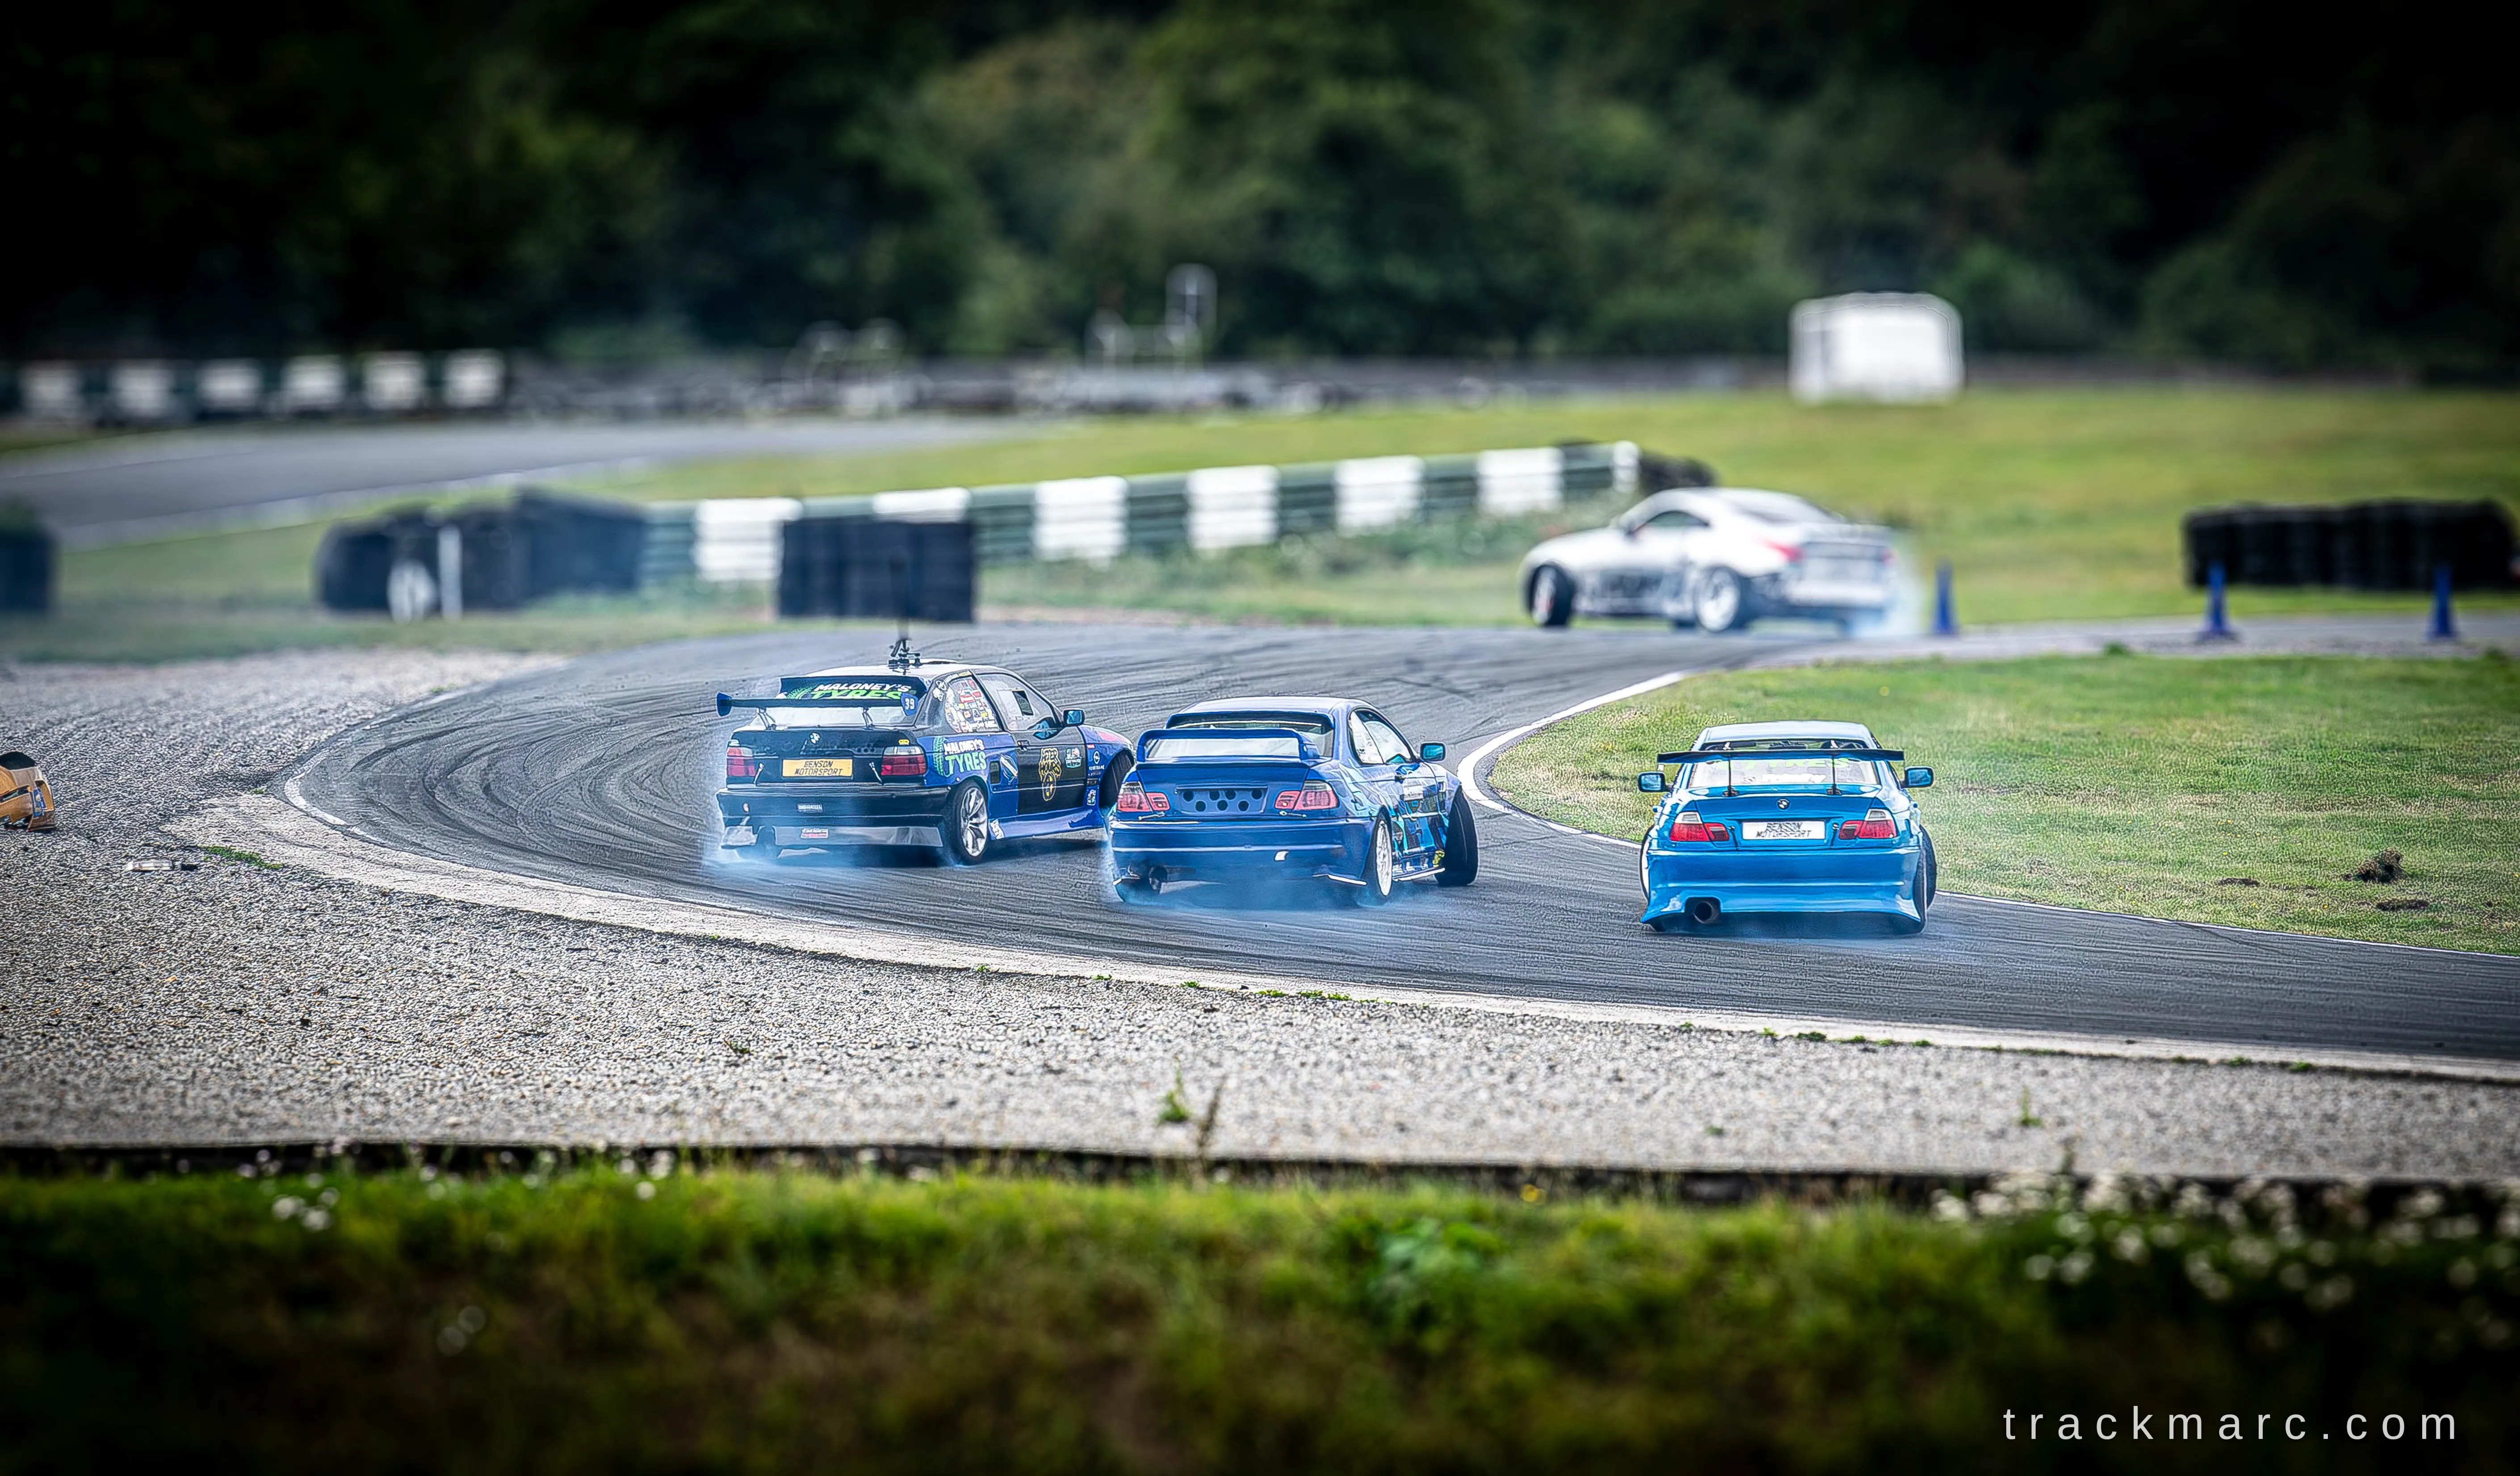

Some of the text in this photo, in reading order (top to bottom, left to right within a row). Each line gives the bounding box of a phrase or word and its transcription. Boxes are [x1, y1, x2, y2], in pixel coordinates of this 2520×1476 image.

[814, 683, 911, 692] MALONEY'S
[904, 698, 914, 710] 39
[943, 738, 985, 755] MALONEY'S
[945, 751, 987, 775] TYRES
